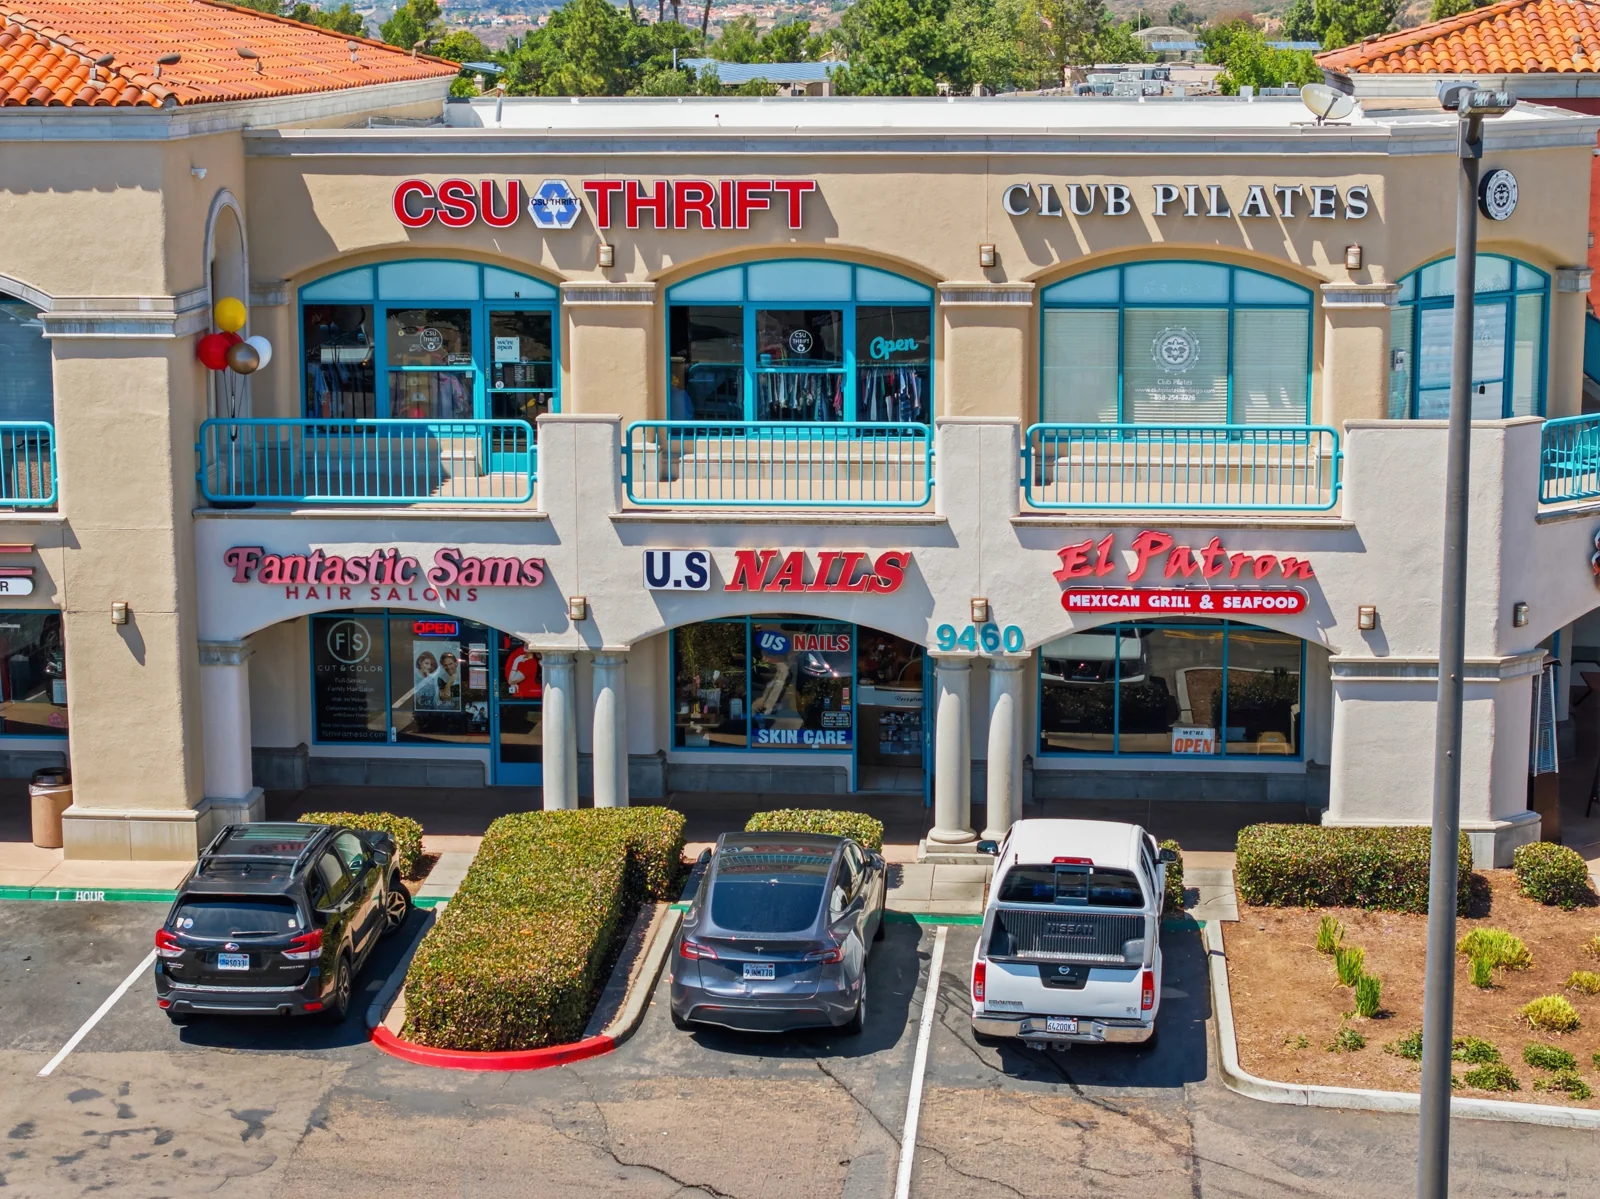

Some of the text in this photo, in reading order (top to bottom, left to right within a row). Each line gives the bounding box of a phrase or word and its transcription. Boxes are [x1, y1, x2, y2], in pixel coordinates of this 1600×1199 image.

[393, 179, 816, 229] CSU THRIFT
[531, 198, 578, 206] CSU THRIFT
[1003, 182, 1369, 219] CLUB PILATES
[870, 336, 918, 360] Open
[1052, 530, 1315, 583] El Patron
[224, 546, 545, 587] Fantastic Sams
[646, 549, 912, 595] U.S NAILS
[285, 586, 478, 602] HAIR SALONS
[1069, 594, 1298, 609] MEXICAN GRILL & SEAFOOD
[413, 622, 456, 634] OPEN
[793, 633, 850, 652] NAILS
[936, 623, 1024, 653] 9460
[349, 665, 383, 673] COLOR
[758, 729, 847, 745] SKIN CARE
[1174, 738, 1212, 753] OPEN
[55, 890, 105, 902] 1 HOUR
[1046, 922, 1094, 936] NISSAN
